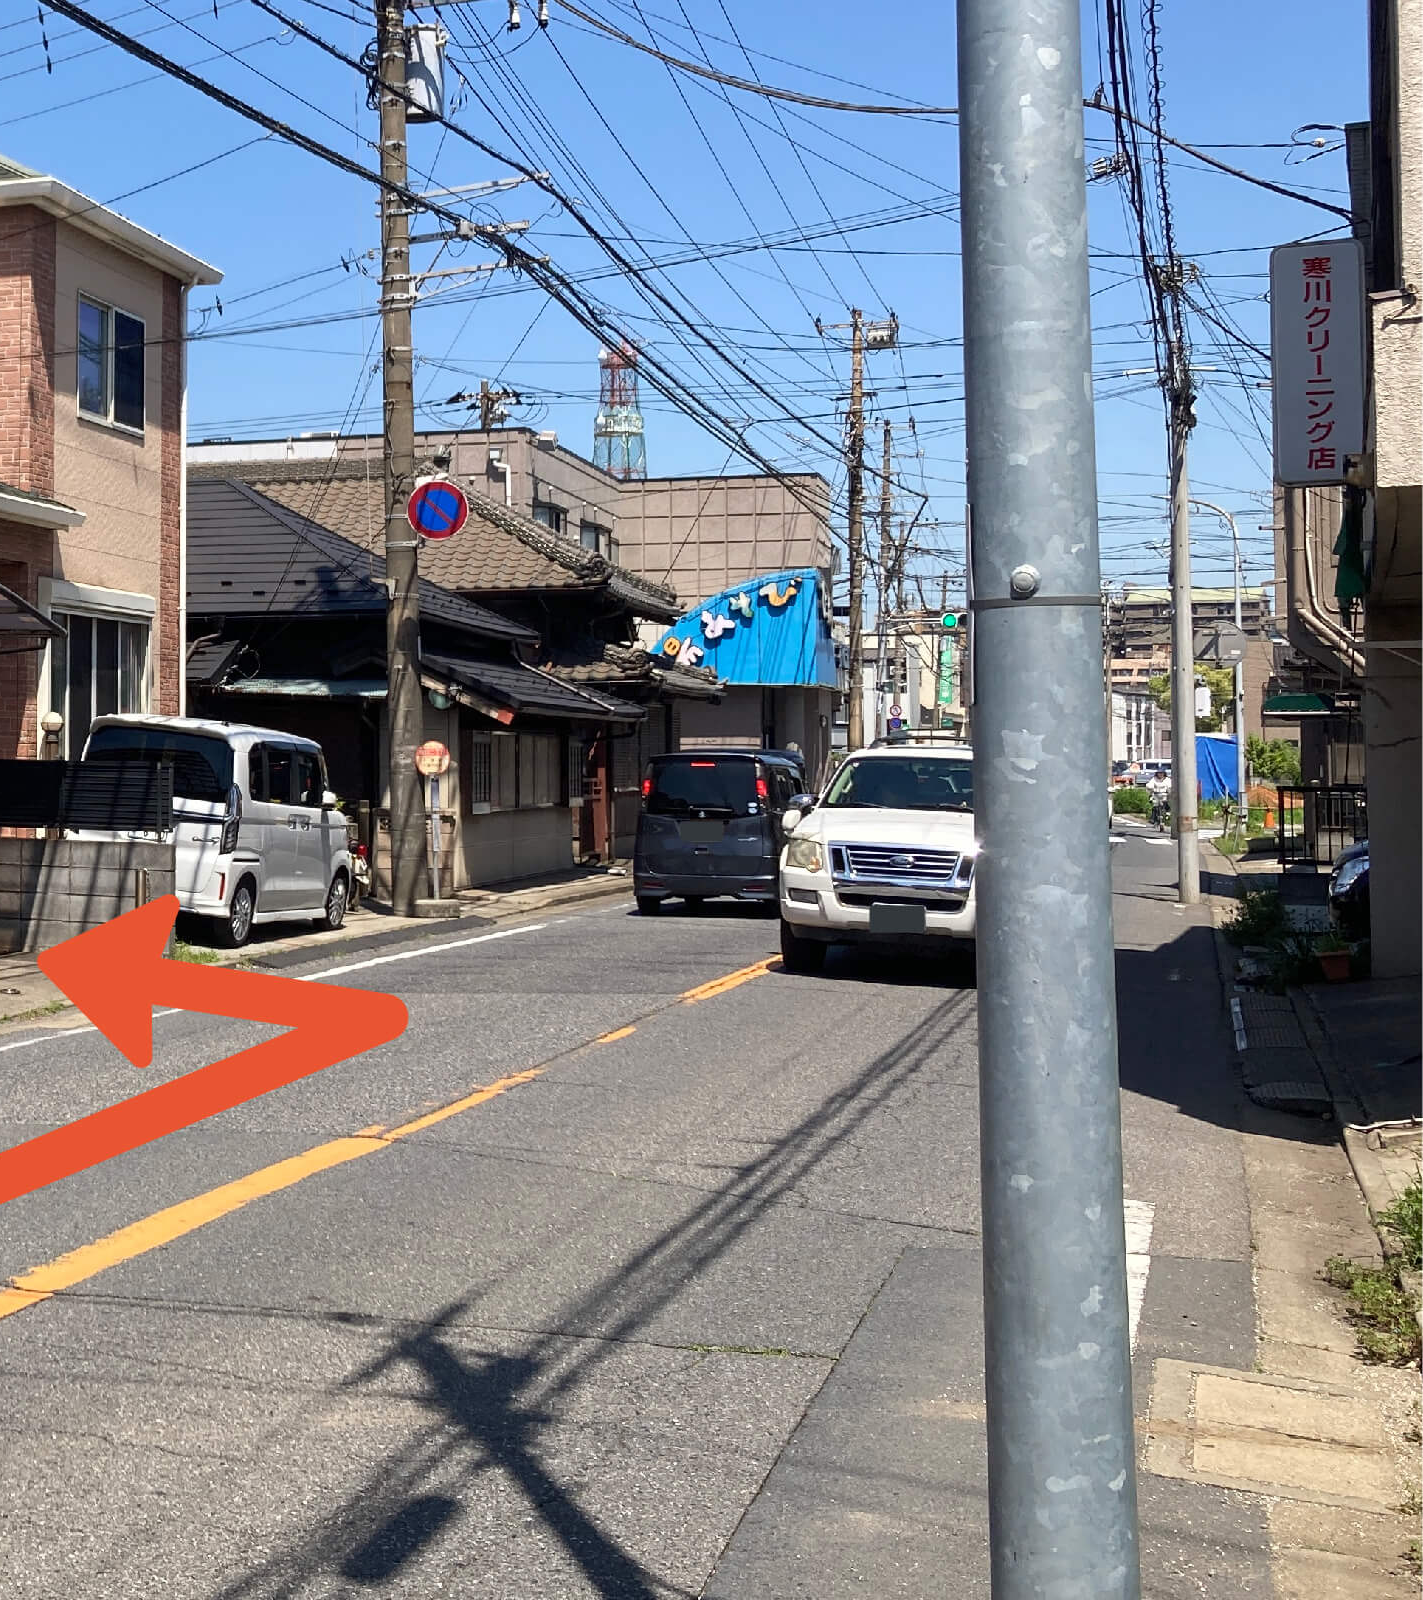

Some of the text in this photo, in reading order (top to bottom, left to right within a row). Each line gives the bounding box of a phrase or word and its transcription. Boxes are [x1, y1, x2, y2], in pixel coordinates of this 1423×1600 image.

[1302, 256, 1336, 471] 寒川クリーニング店
